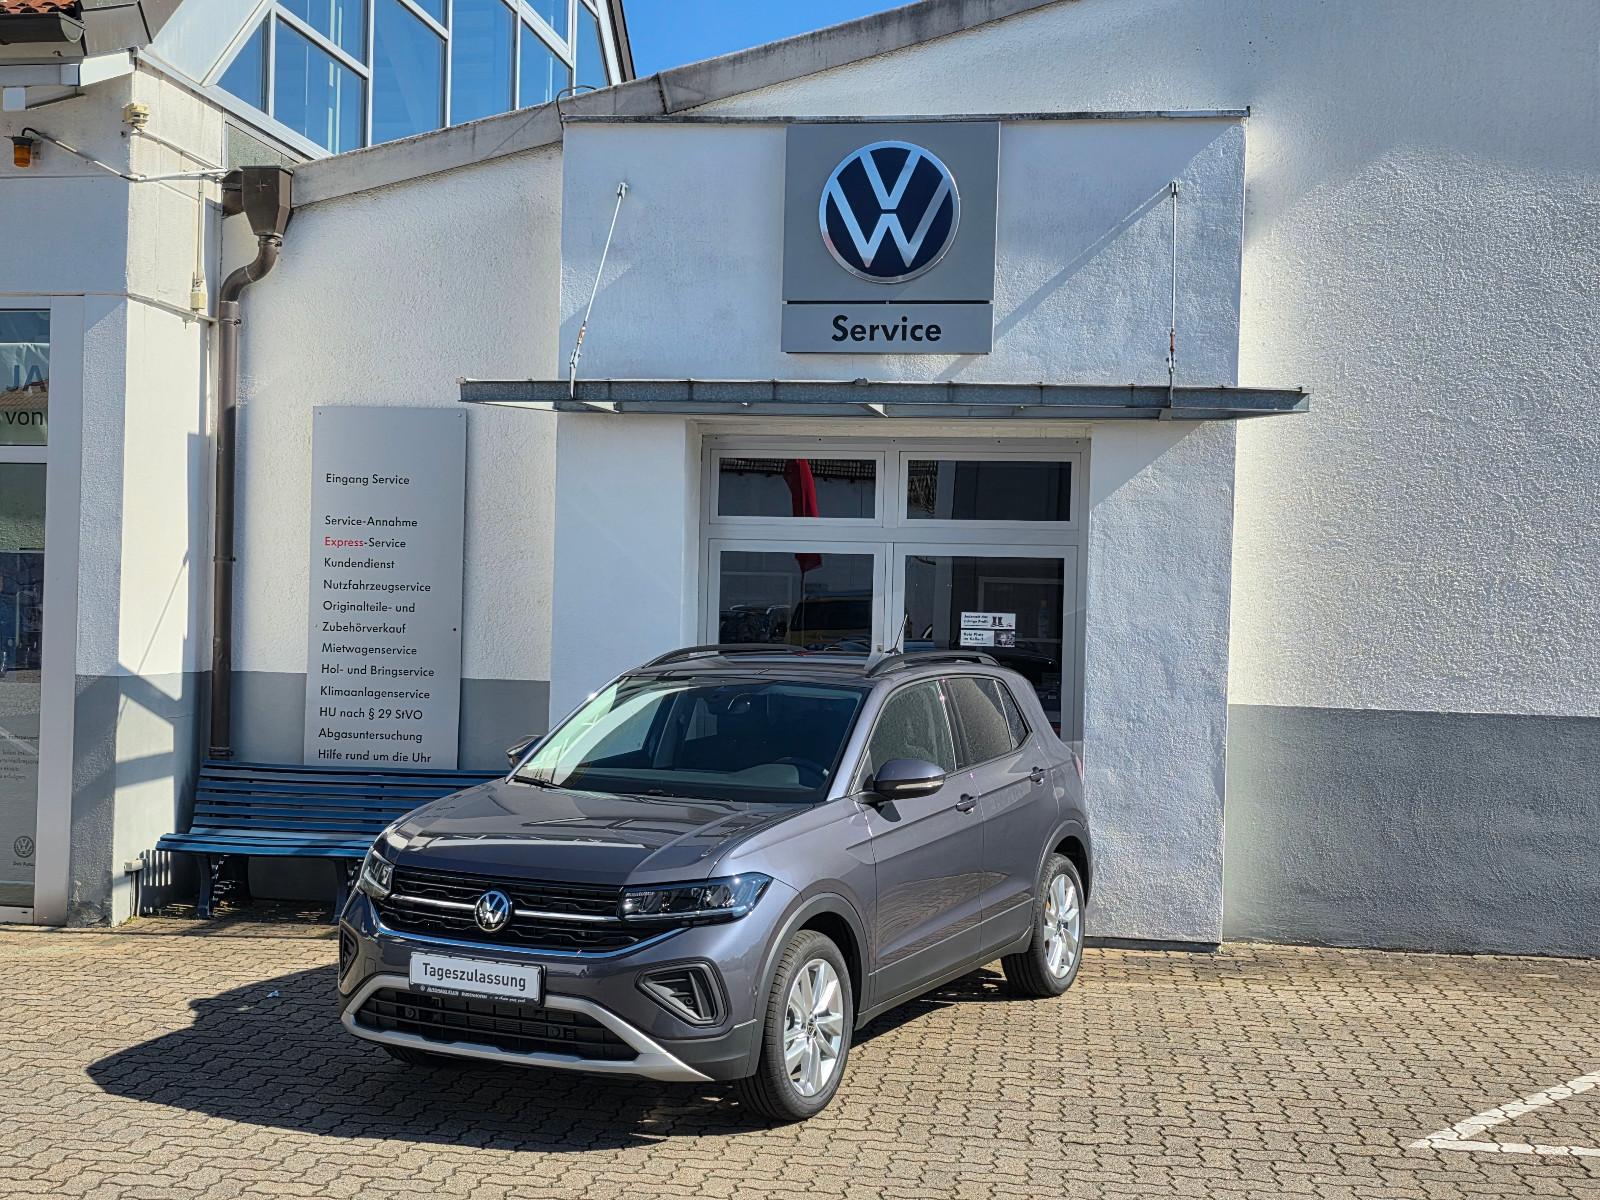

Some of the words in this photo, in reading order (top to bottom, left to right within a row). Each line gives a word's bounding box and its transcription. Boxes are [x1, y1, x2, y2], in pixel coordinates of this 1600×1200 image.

[831, 314, 942, 342] Service
[5, 411, 44, 426] von
[325, 473, 369, 486] Eingang
[372, 473, 410, 485] Service
[324, 515, 418, 527] Service-Annahme
[324, 536, 407, 548] Express-Service
[324, 557, 395, 569] Kundendienst
[323, 579, 431, 593] Nutzfahrzeugservice
[322, 600, 392, 613] Originalteile-
[395, 602, 416, 613] und
[322, 621, 407, 634] Zubehörverkauf
[321, 642, 417, 656] Mietwagenservice
[321, 663, 344, 675] Hol-
[347, 664, 367, 675] und
[370, 666, 435, 678] Bringservice
[320, 685, 430, 699] Klimaanlagenservice
[319, 706, 337, 717] HU
[340, 707, 365, 718] nach
[368, 708, 375, 720] §
[378, 709, 392, 719] 29
[395, 709, 423, 720] StVO
[318, 728, 423, 743] Abgasuntersuchung
[318, 749, 342, 760] Hilfe
[345, 750, 370, 761] rund
[373, 754, 389, 762] um
[392, 752, 409, 763] die
[412, 753, 432, 763] Uhr
[422, 961, 526, 991] Tageszulassung
